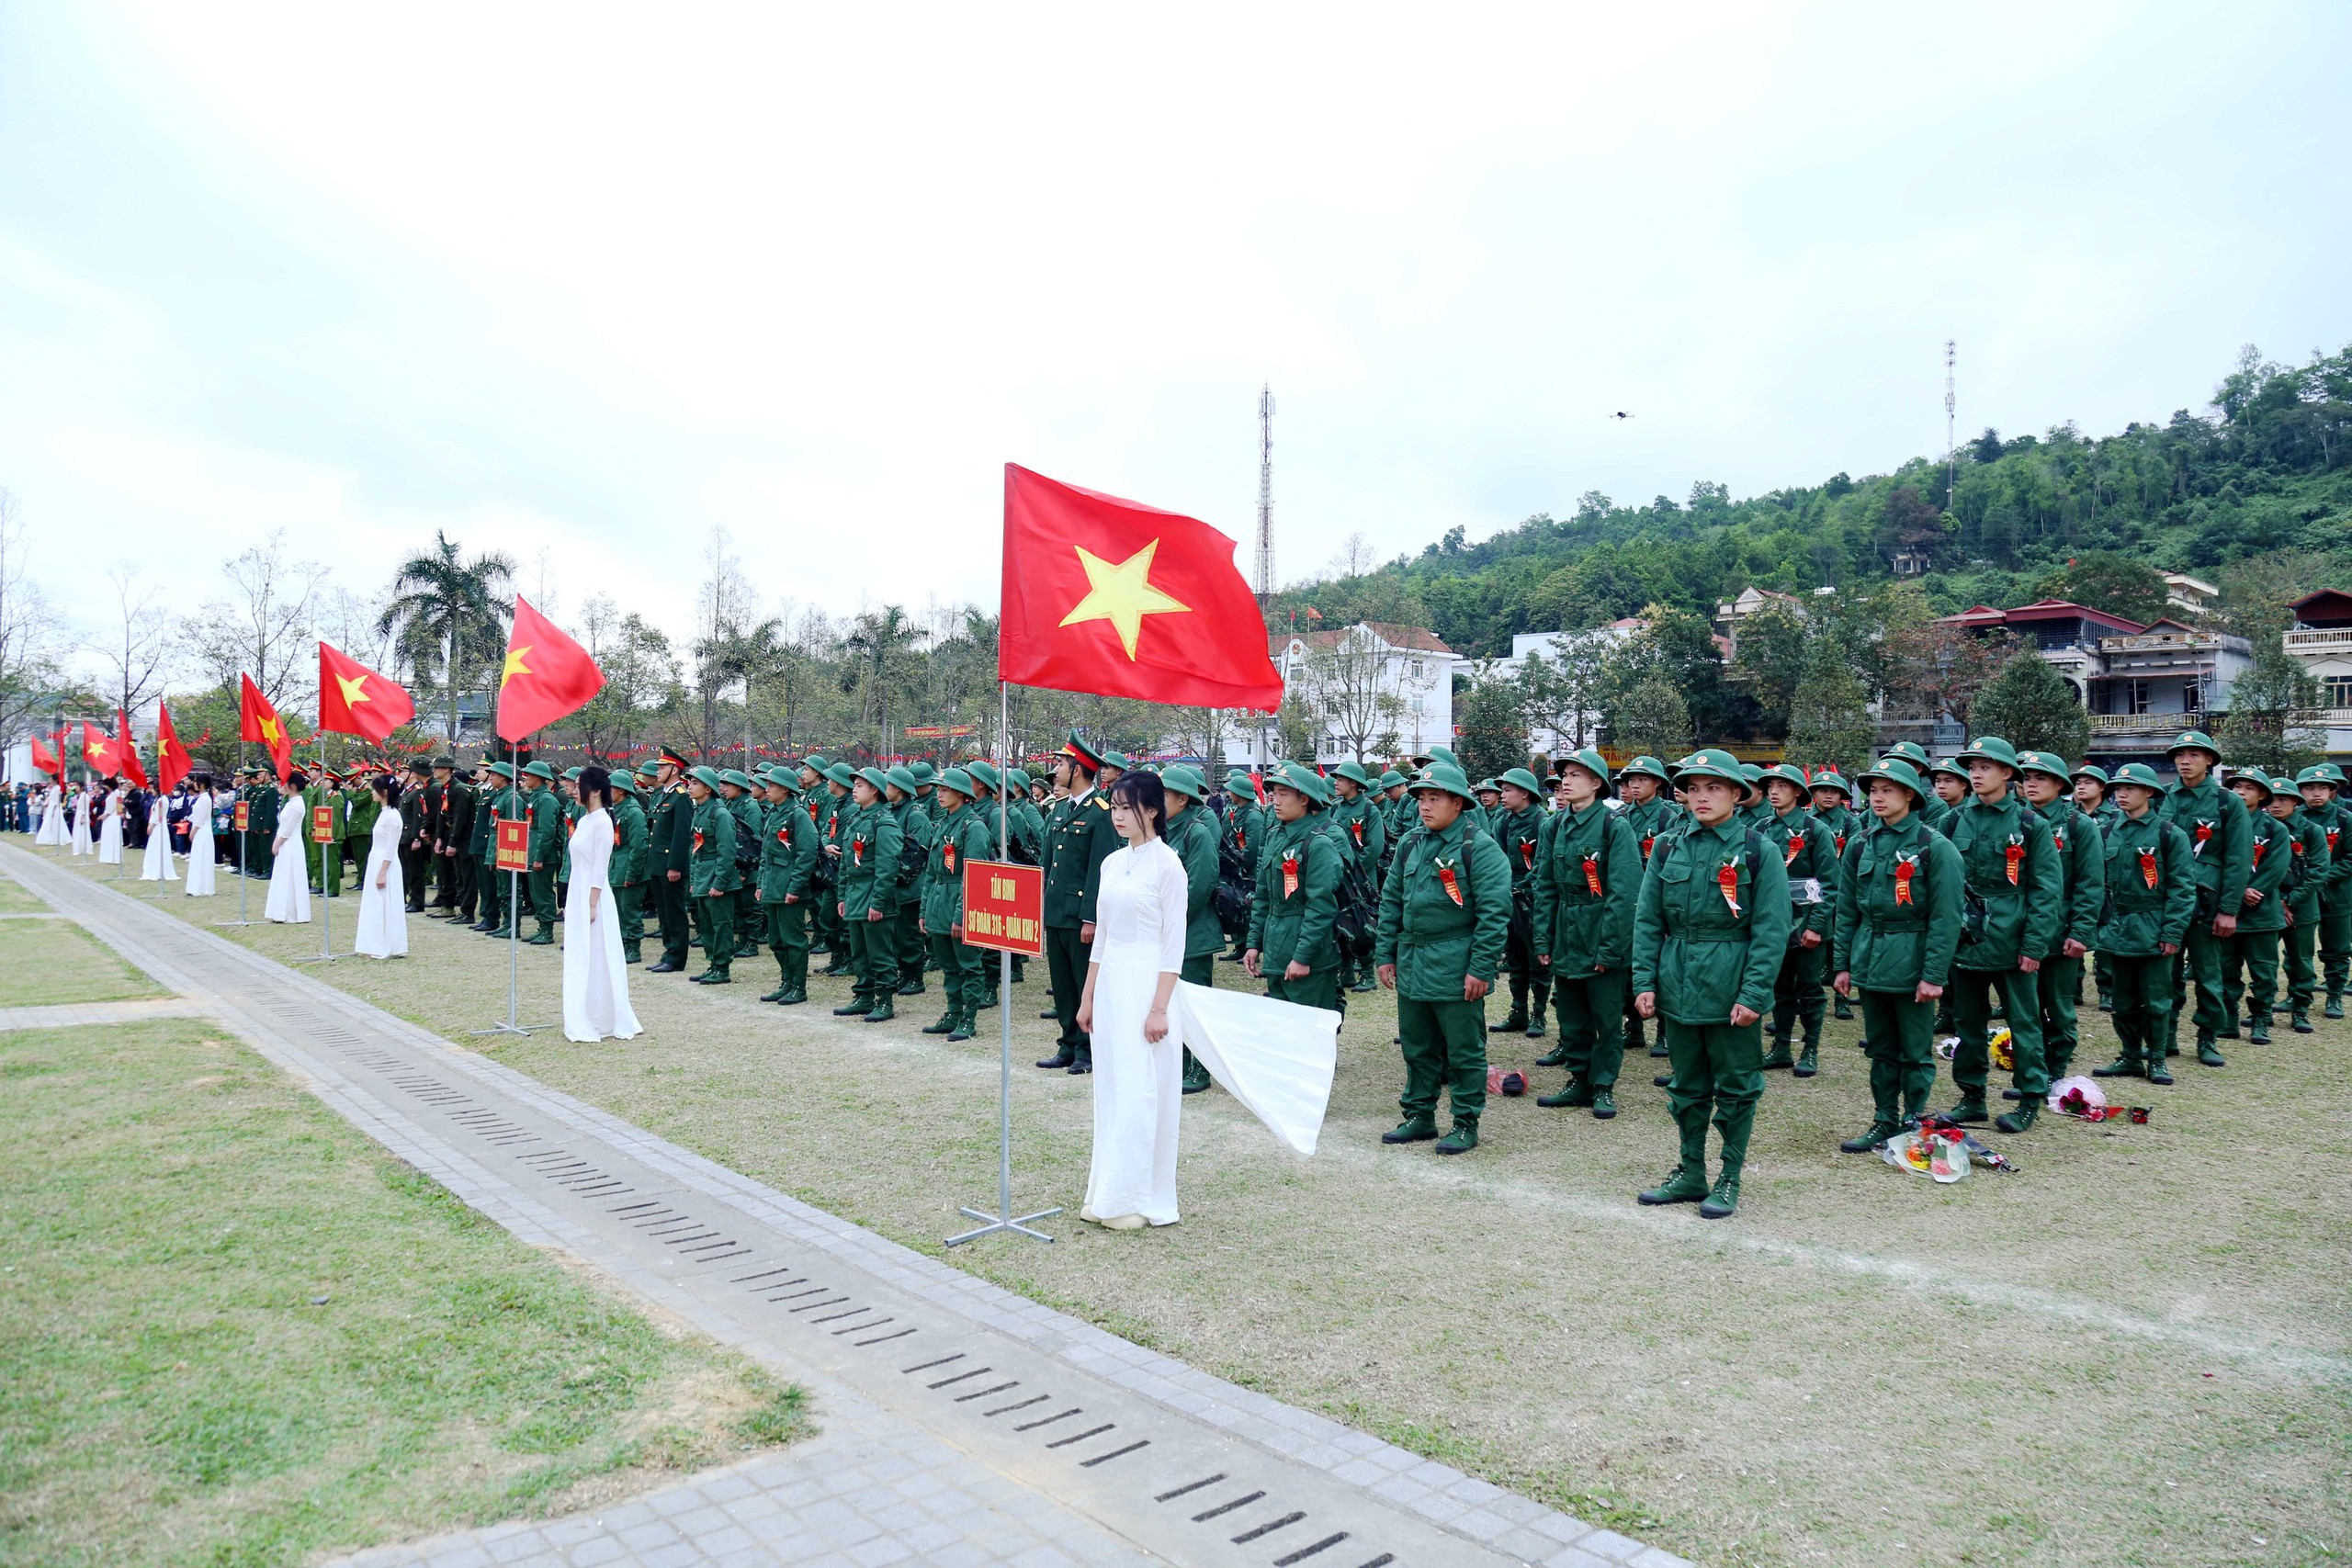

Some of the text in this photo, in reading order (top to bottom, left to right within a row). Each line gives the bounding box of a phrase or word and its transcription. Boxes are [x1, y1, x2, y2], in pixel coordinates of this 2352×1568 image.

[990, 872, 1016, 902] TÂN BINH
[968, 908, 977, 932] SƯ
[976, 908, 991, 935] ĐOÀN
[991, 914, 1002, 937] 316
[1006, 912, 1022, 941] QUÂN
[1022, 919, 1034, 942] KHU
[1034, 920, 1039, 942] 2
